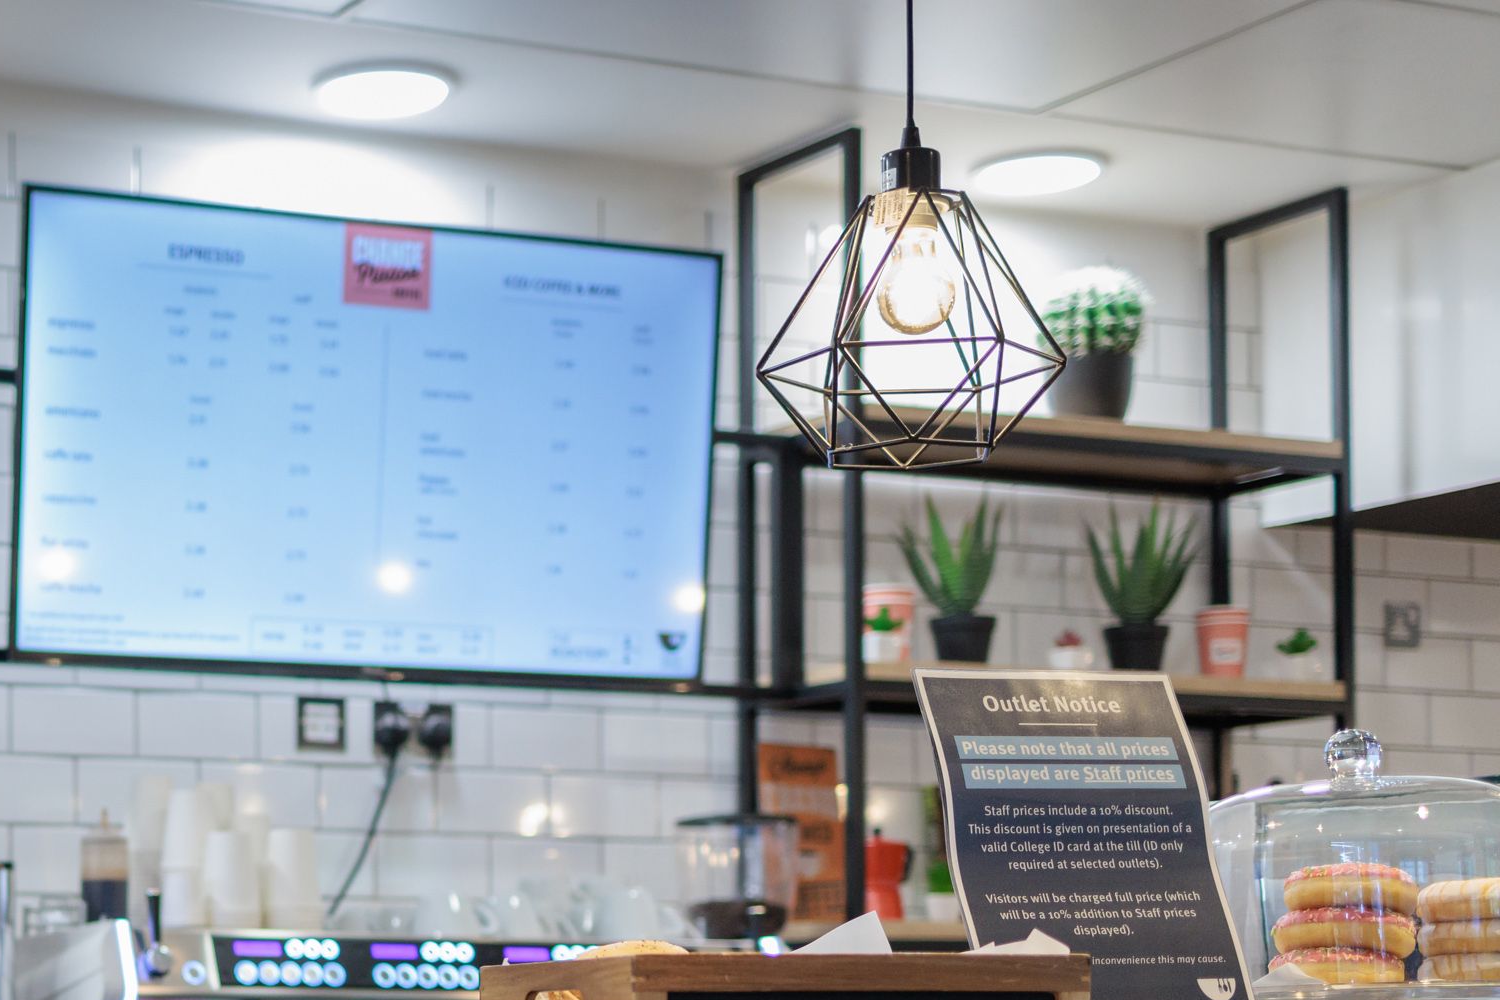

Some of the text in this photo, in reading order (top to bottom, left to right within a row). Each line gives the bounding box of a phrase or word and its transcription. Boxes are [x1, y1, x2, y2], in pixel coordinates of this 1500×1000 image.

[983, 694, 1122, 714] Outlet Notice
[961, 741, 1170, 759] Please note that all prices
[971, 766, 1176, 784] displayed are Staff prices
[984, 804, 1173, 818] Staff prices include a 10% discount.
[968, 822, 1192, 837] This discount is given on presentation of a
[981, 840, 1183, 854] valid College ID card at the till (ID only
[1008, 857, 1163, 872] required at selected outlets).
[985, 891, 1201, 906] Visitors will be charged full price (which
[1000, 908, 1196, 920] will be a 10% addition to Staff prices
[1073, 924, 1134, 937] displayed).
[1092, 955, 1226, 967] inconvenience this may cause.
